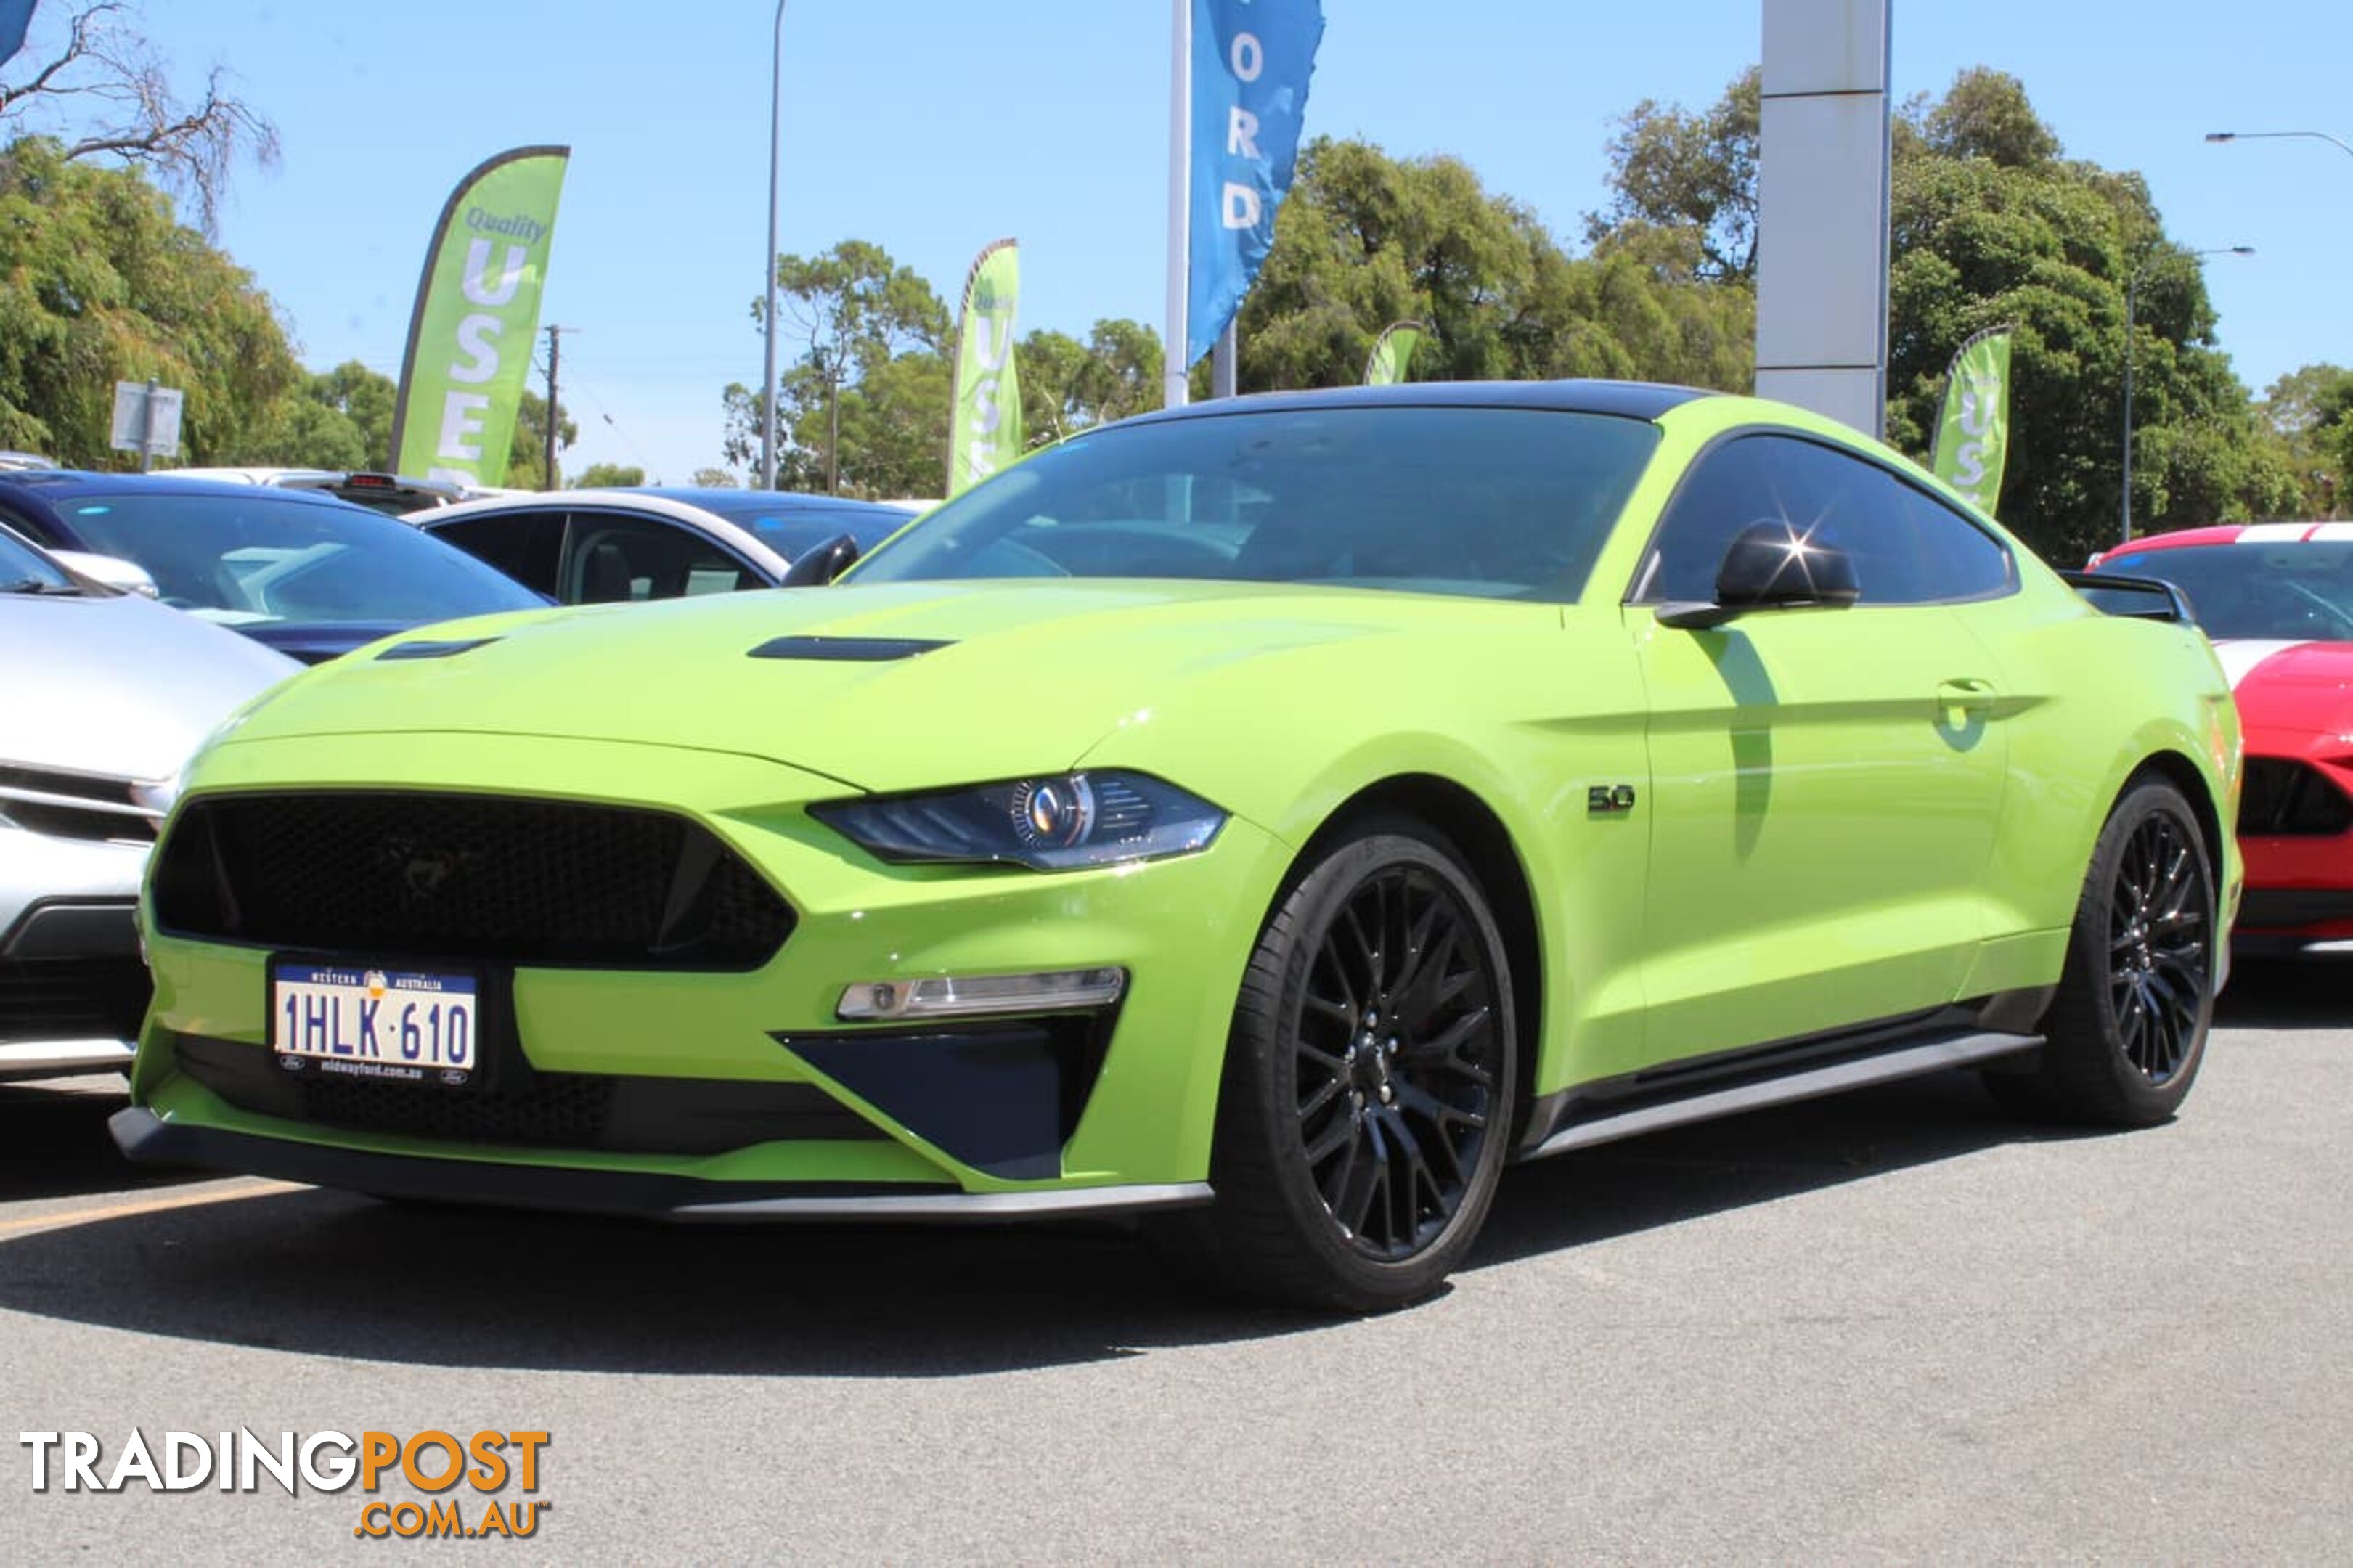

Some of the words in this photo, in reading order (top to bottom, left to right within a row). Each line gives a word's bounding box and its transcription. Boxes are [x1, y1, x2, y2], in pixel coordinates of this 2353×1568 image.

[1222, 0, 1265, 229] ORD
[465, 206, 547, 242] Quality
[396, 977, 442, 991] AUSTRALIA
